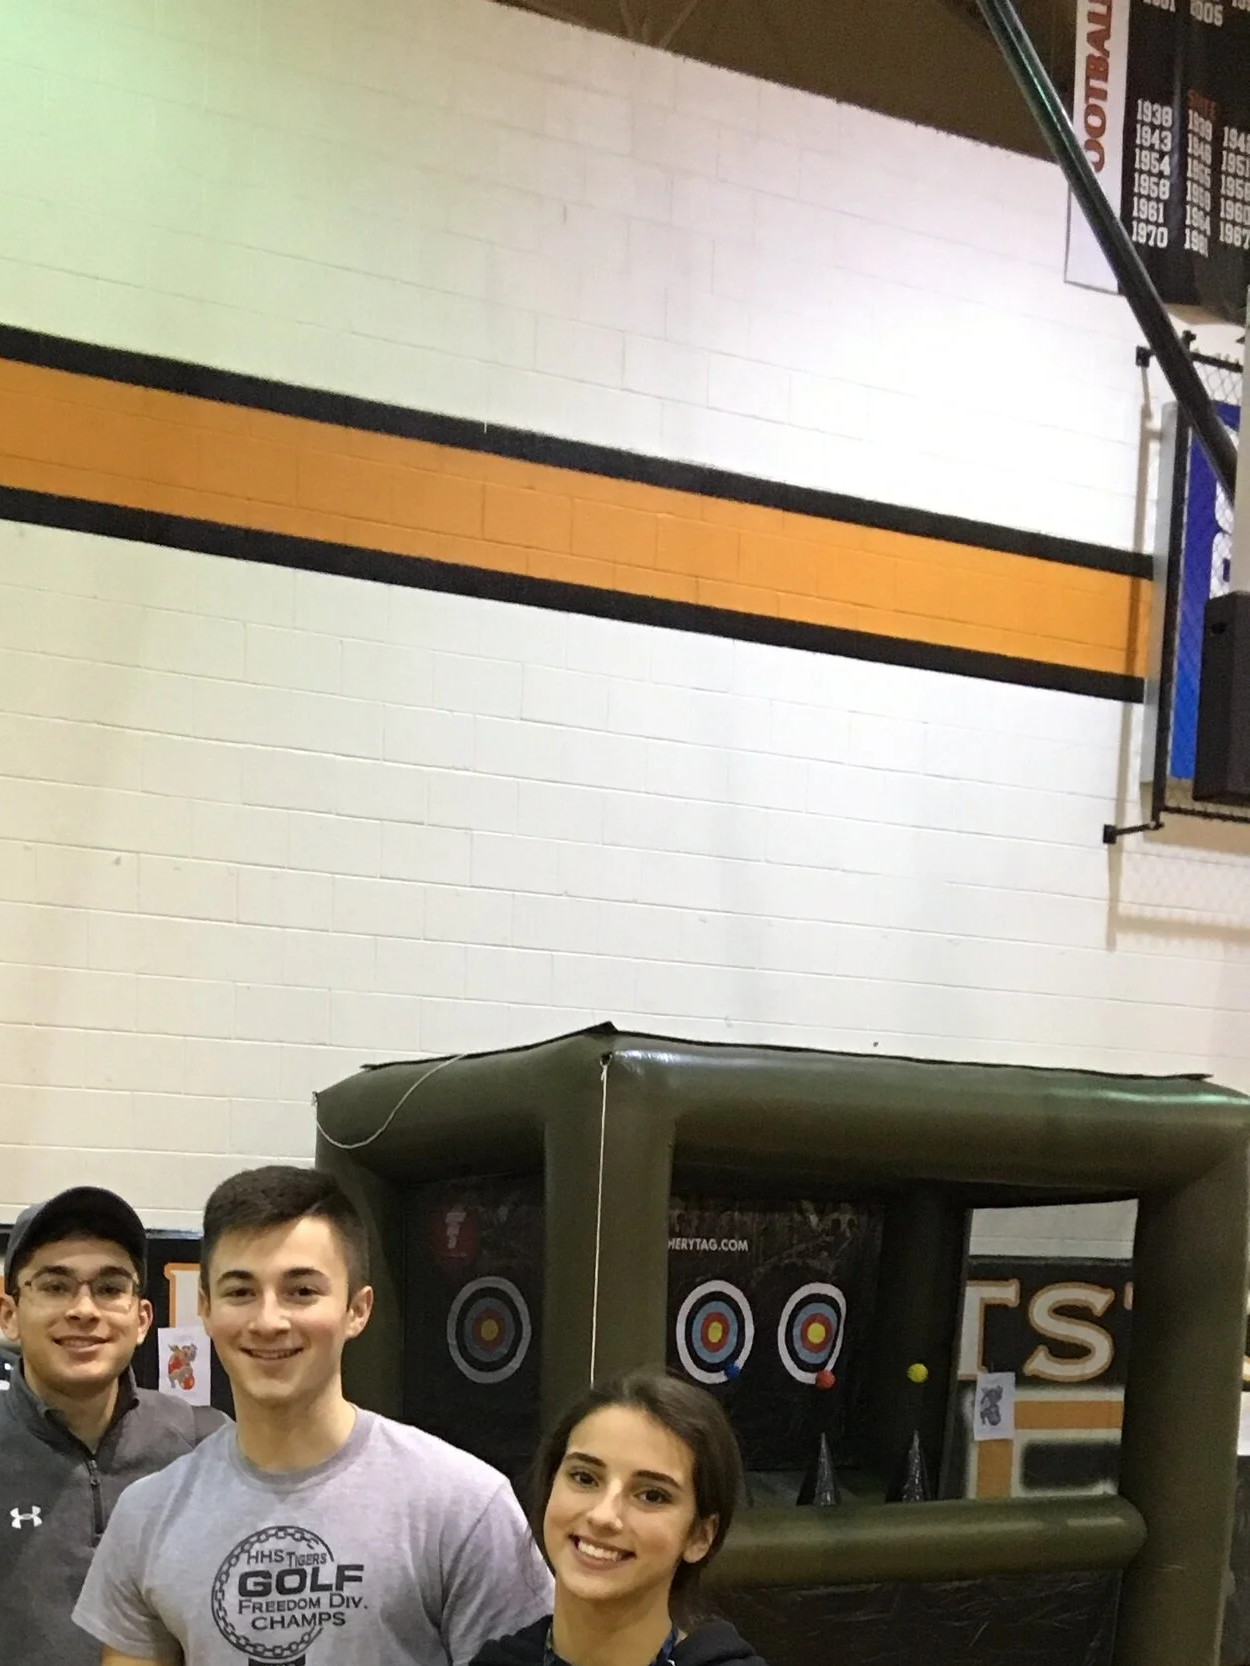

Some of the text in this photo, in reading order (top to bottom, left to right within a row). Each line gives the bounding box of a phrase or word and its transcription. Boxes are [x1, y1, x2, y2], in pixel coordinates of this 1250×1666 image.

[1137, 98, 1173, 128] 1938
[1136, 123, 1172, 152] 1943
[1135, 148, 1170, 176] 1954
[1134, 172, 1170, 200] 1958
[1132, 196, 1164, 224] 1961
[1219, 220, 1250, 250] 1967
[1132, 220, 1168, 248] 1970
[247, 1550, 283, 1565] HHS
[238, 1564, 364, 1597] GOLF
[251, 1611, 346, 1630] CHAMPS
